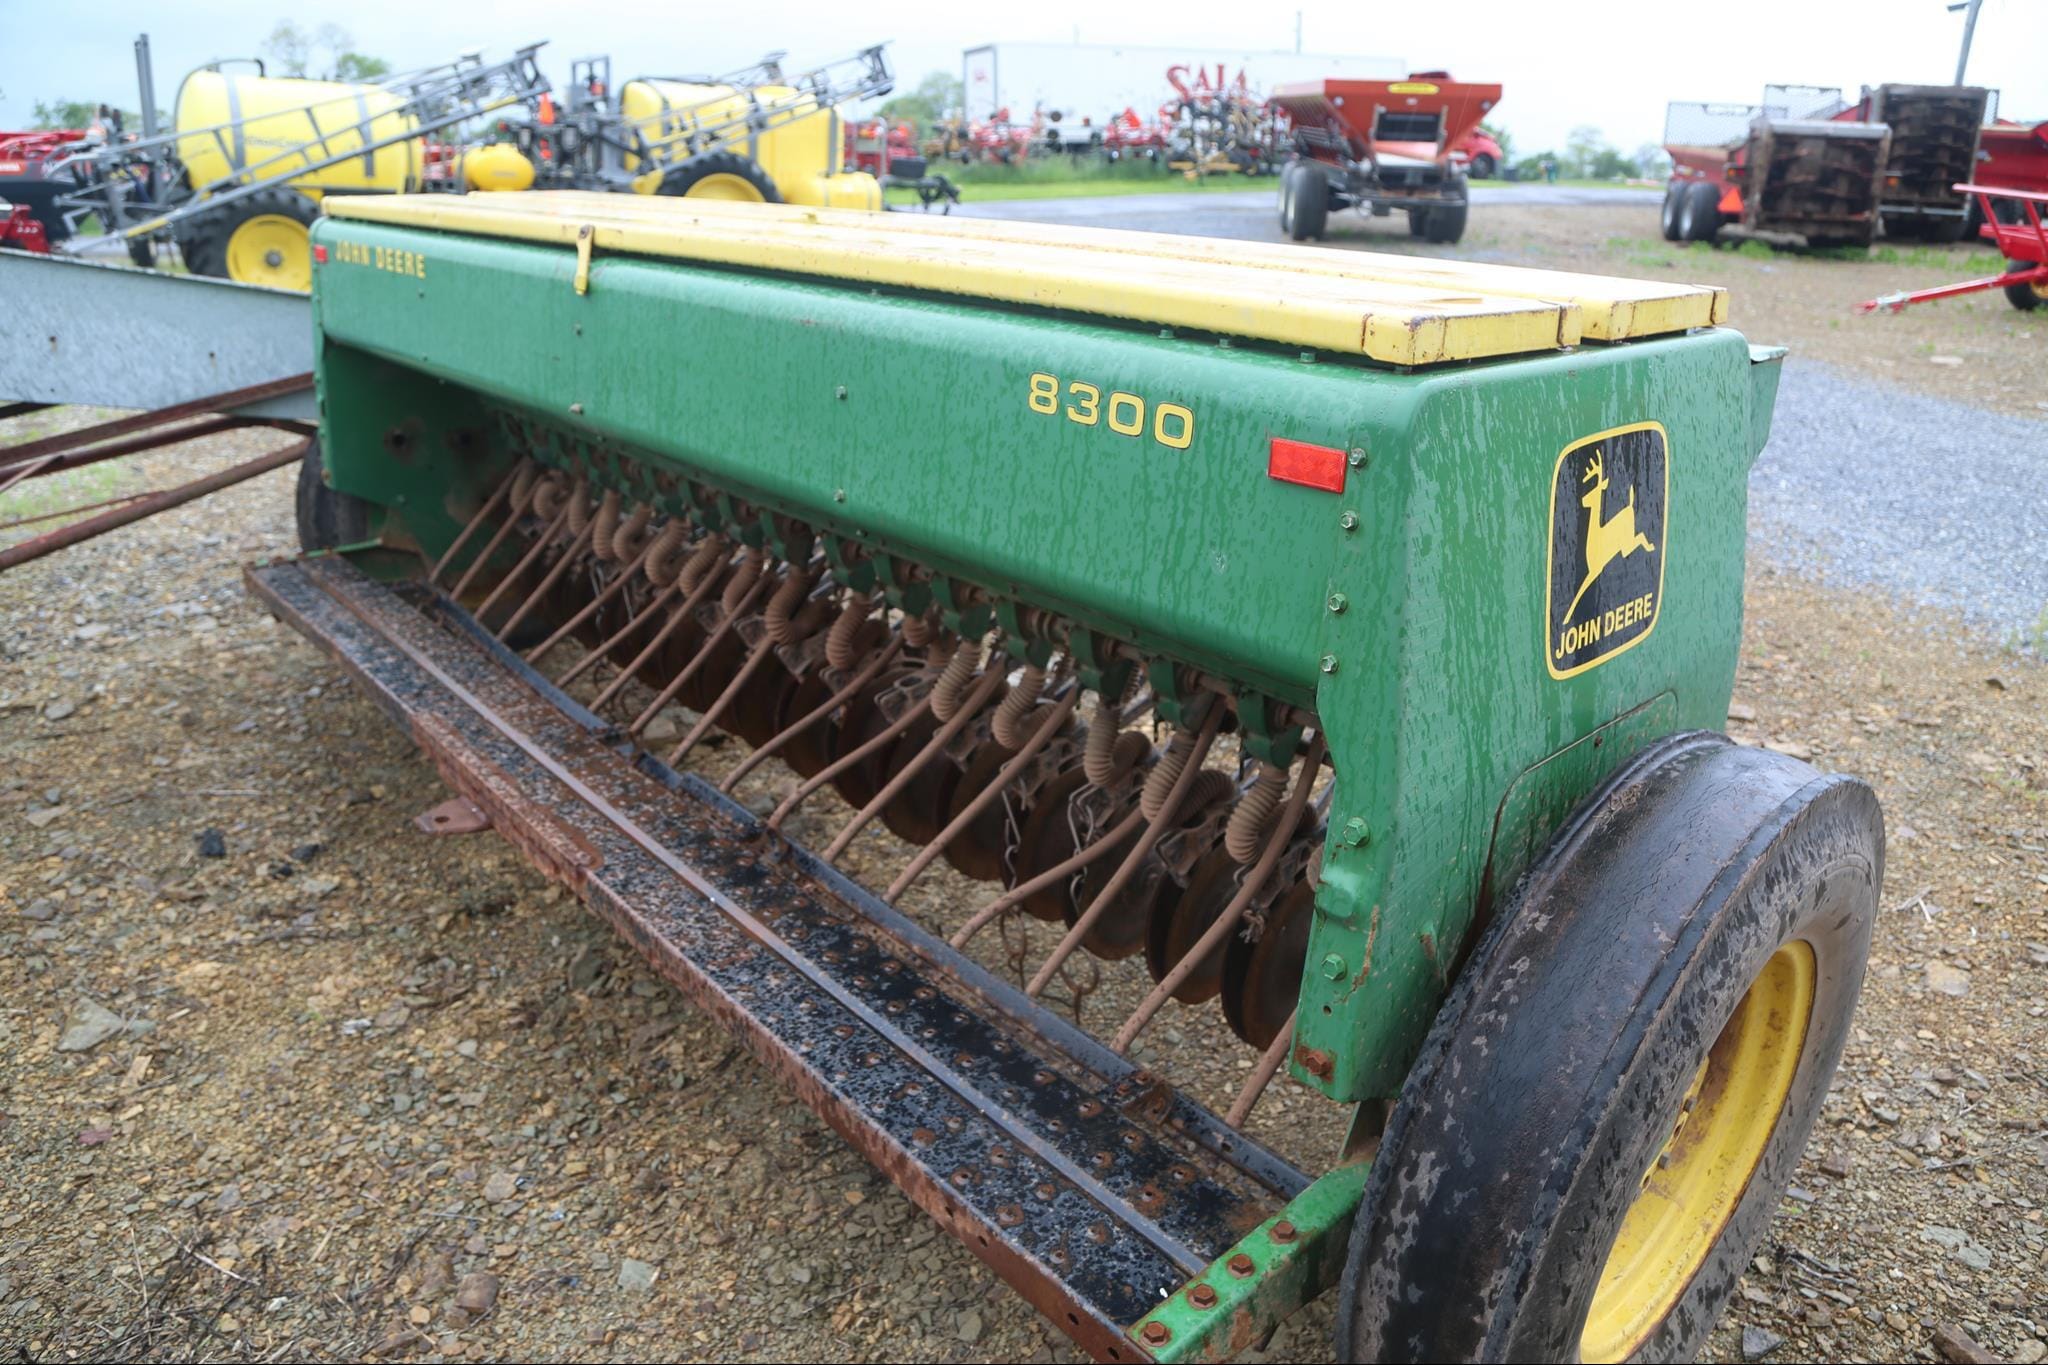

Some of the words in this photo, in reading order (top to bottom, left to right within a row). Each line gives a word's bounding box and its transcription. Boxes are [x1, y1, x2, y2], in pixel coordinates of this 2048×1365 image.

[335, 240, 370, 266] JOHN
[376, 245, 426, 279] DEERE
[1028, 371, 1195, 450] 8300
[1555, 615, 1601, 660] JOHN
[1604, 592, 1653, 637] DEERE
